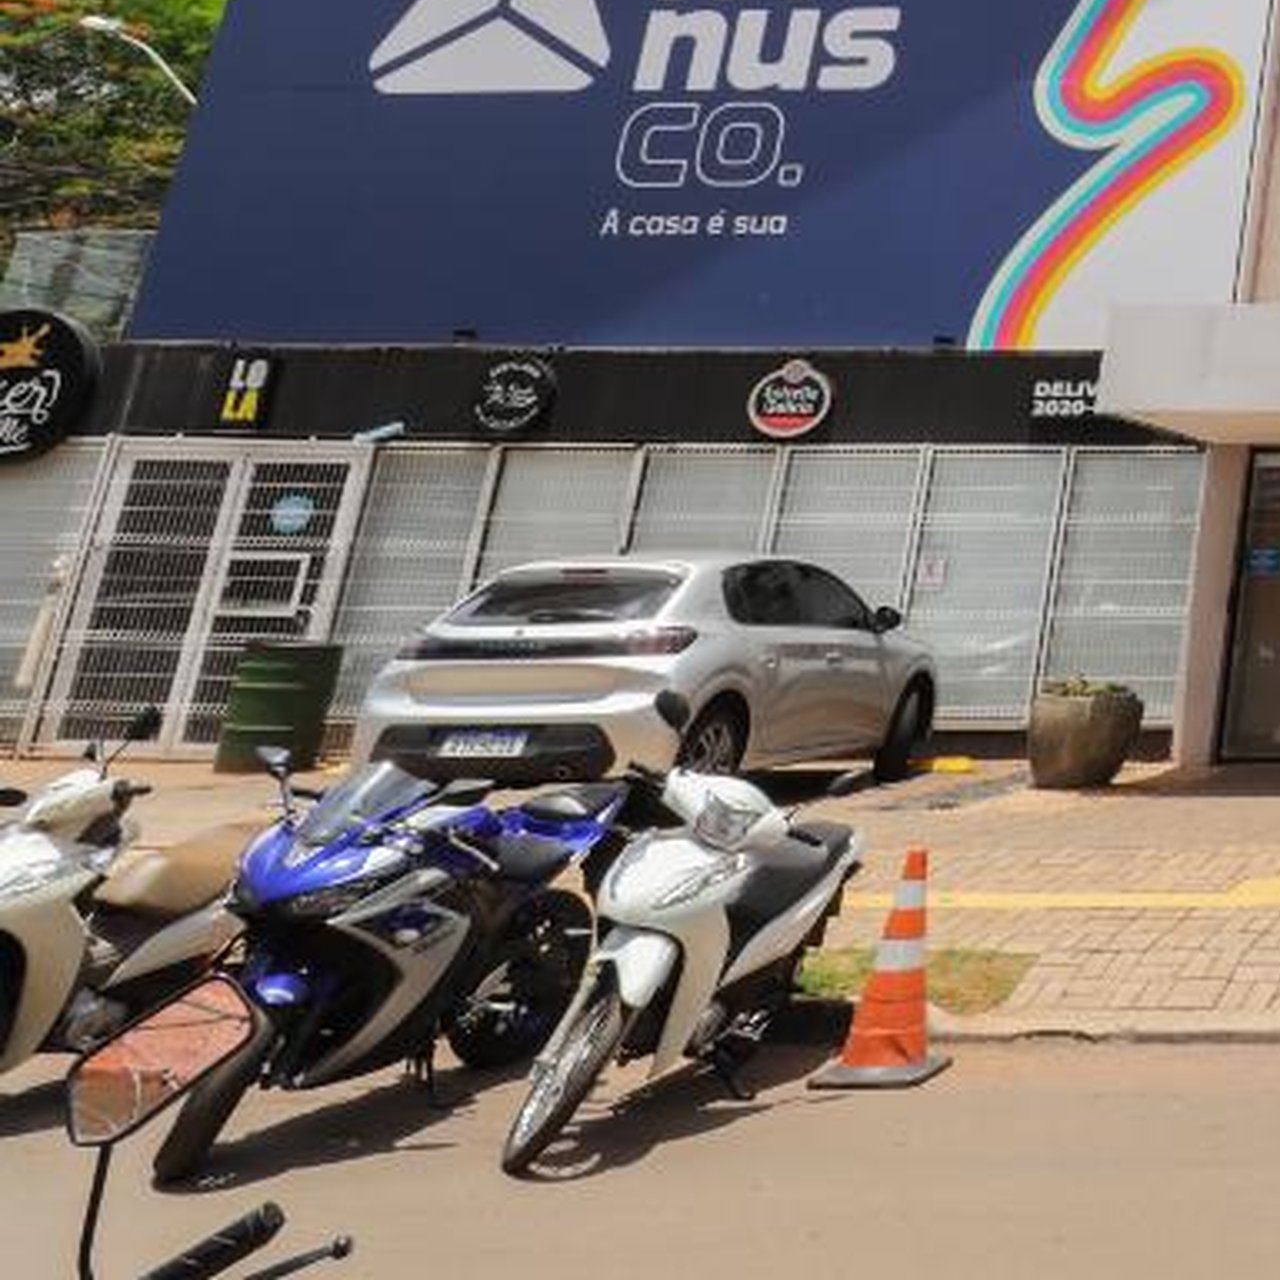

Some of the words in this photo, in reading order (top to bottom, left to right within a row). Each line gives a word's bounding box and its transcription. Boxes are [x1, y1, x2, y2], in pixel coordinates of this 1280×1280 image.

[631, 7, 901, 91] nus
[615, 101, 803, 187] CO.
[600, 207, 619, 236] A
[628, 214, 700, 236] casa
[706, 208, 727, 236] é
[733, 214, 788, 236] sua
[221, 389, 259, 420] LA
[1031, 400, 1100, 417] 2020-
